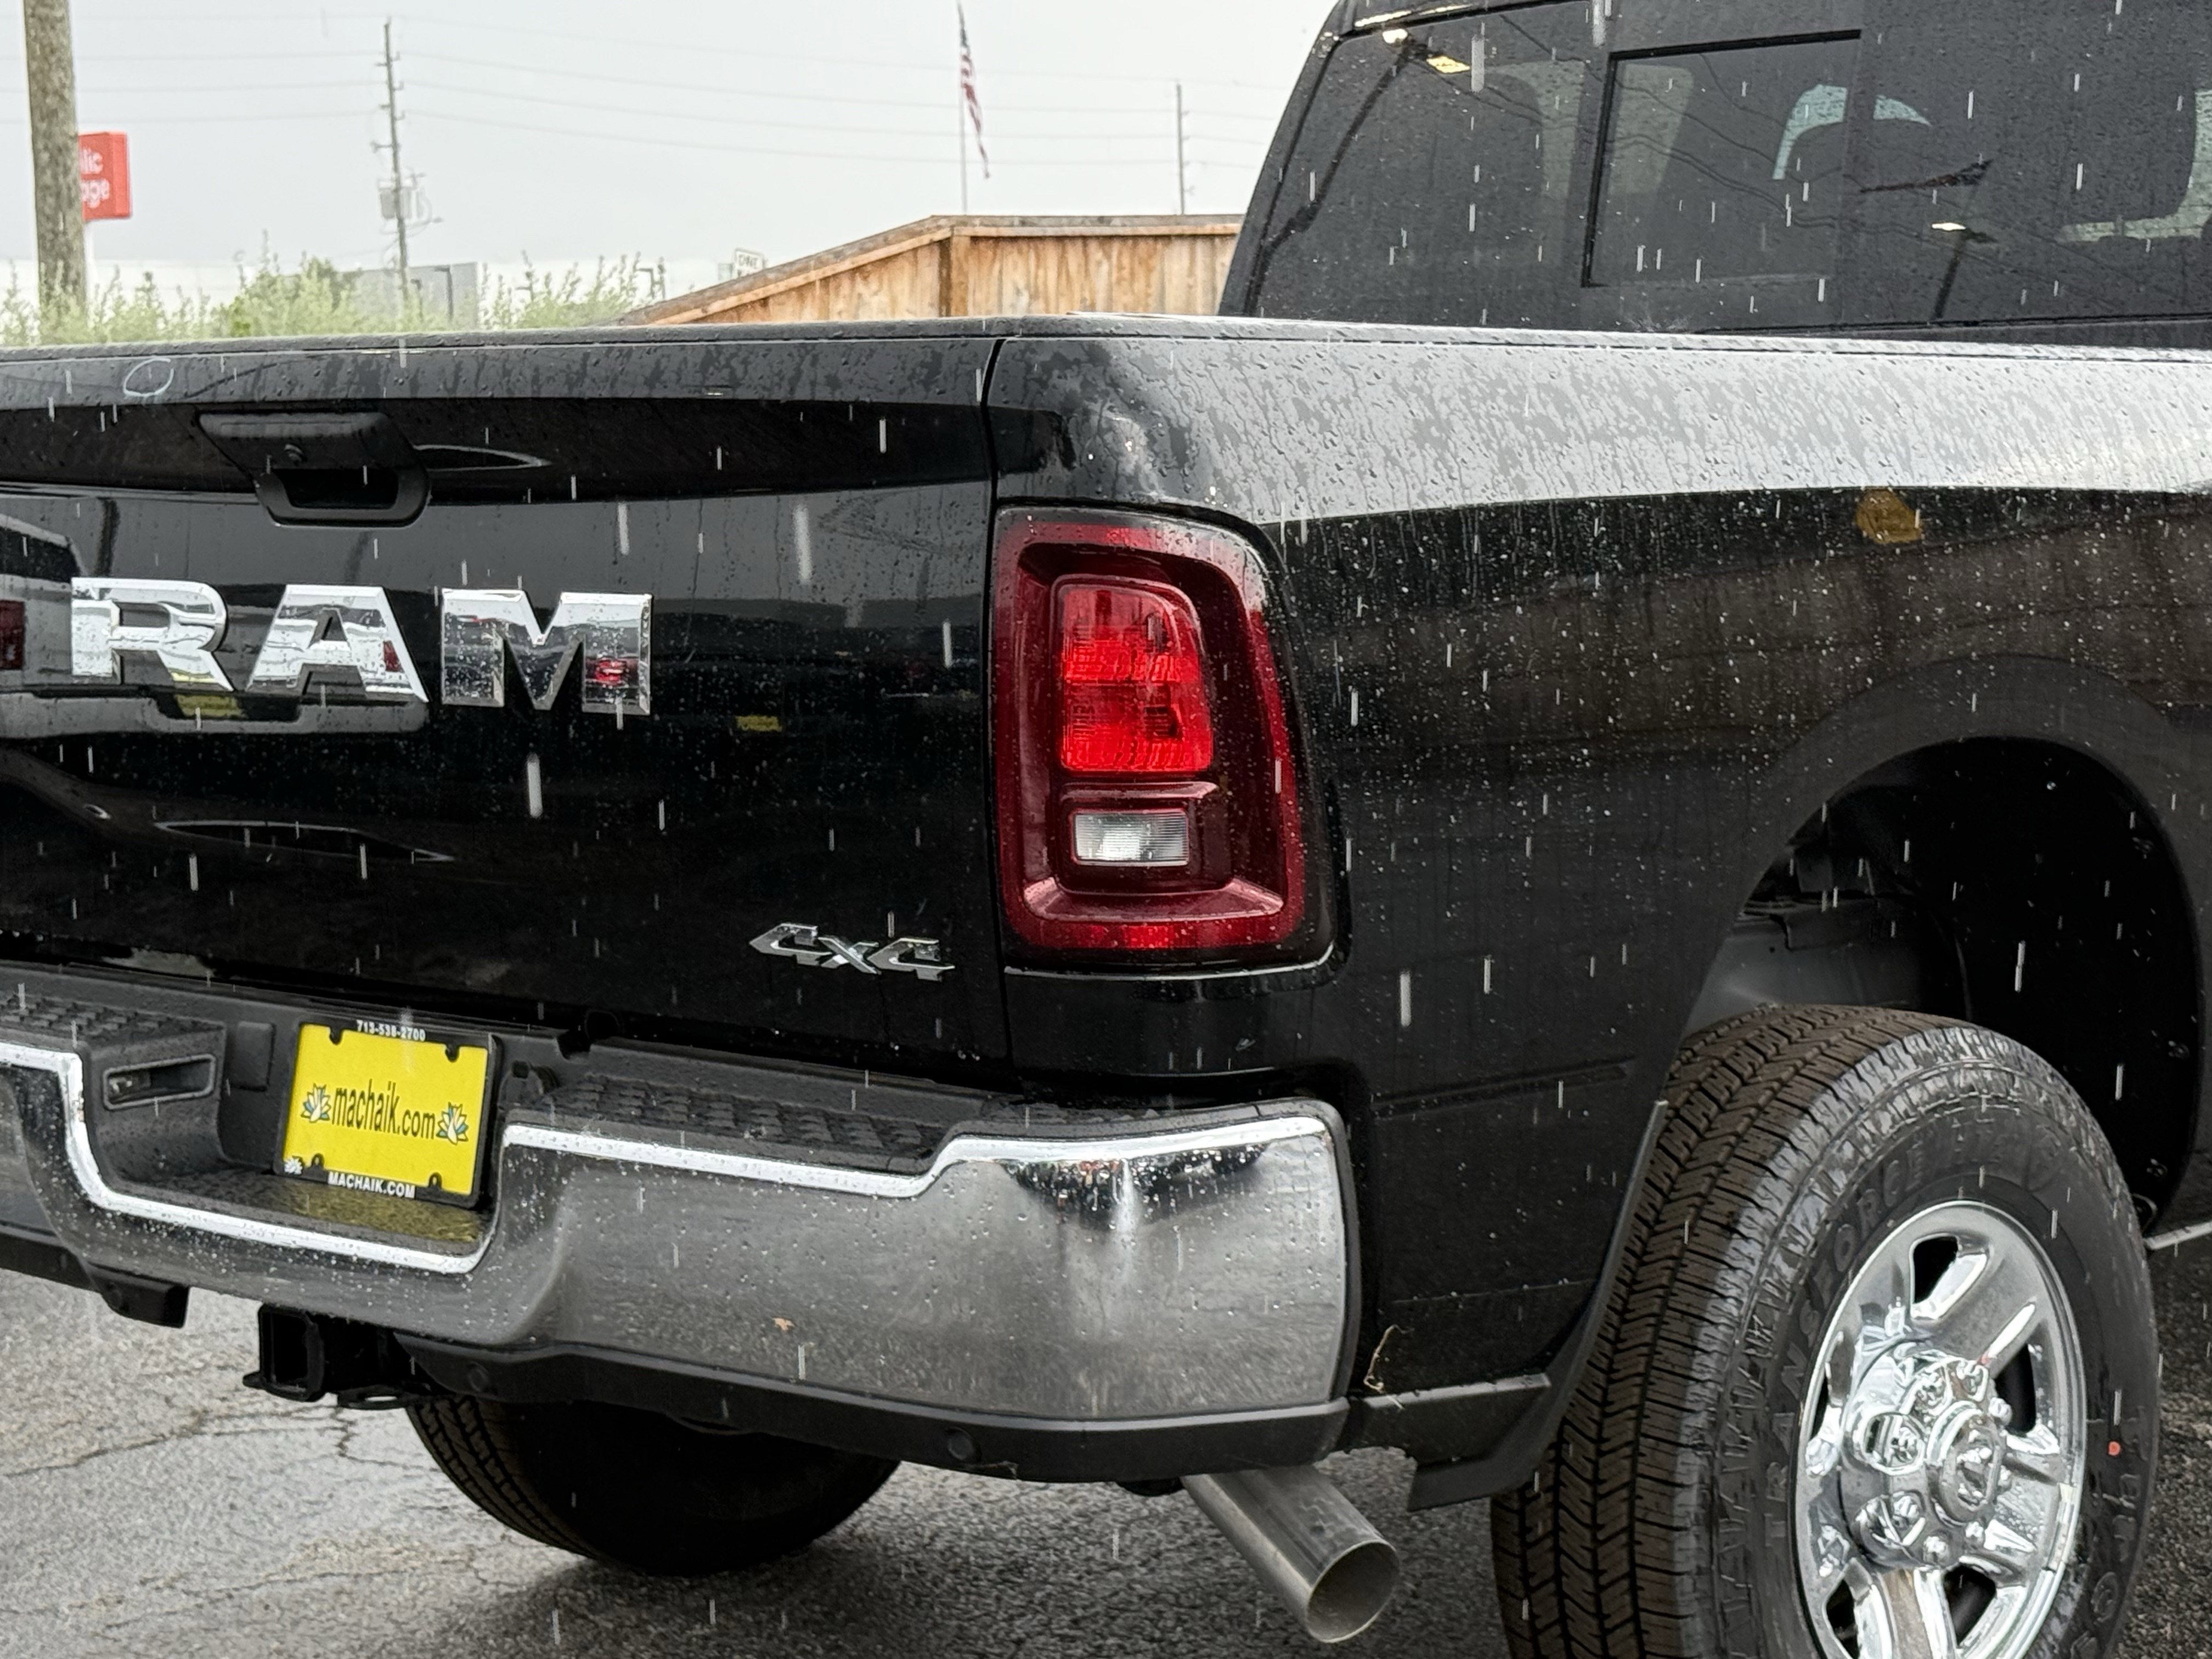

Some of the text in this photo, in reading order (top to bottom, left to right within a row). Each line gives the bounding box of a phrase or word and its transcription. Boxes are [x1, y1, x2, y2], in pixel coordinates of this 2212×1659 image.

[80, 147, 104, 174] lic
[71, 576, 653, 715] RAM
[357, 1019, 426, 1042] 713-538-2700
[331, 1078, 436, 1140] machaik.com
[328, 1171, 416, 1199] MACHAIK.COM
